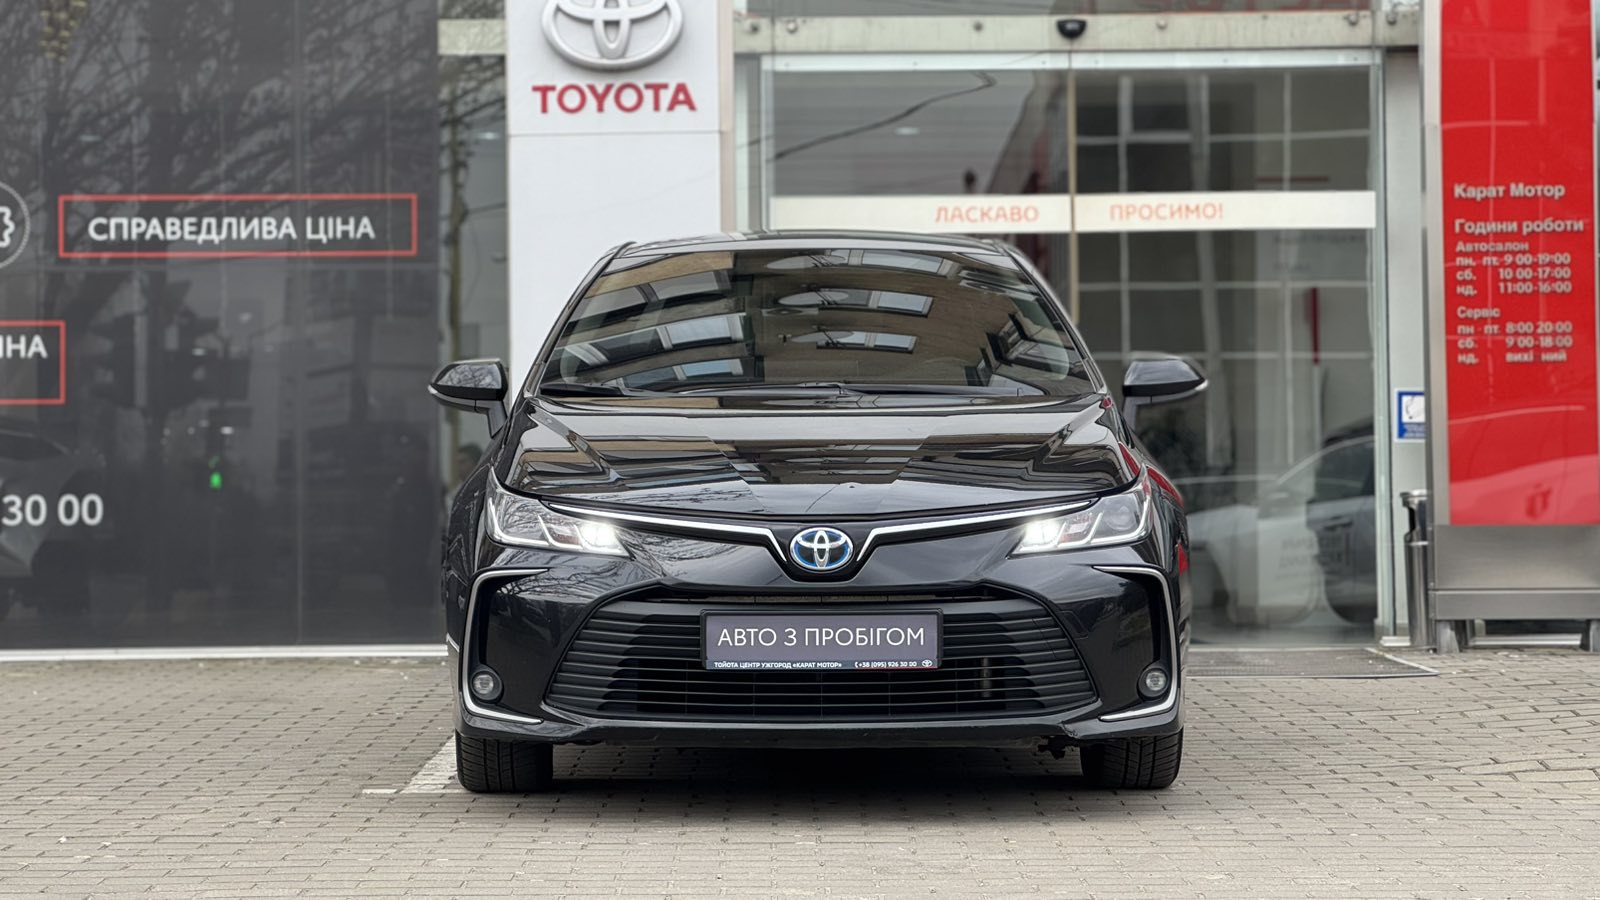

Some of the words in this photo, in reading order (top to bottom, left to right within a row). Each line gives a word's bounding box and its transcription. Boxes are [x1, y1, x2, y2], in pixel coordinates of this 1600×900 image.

[531, 82, 697, 114] TOYOTA
[1454, 182, 1506, 201] Карат
[1509, 182, 1566, 200] Мотор
[934, 206, 1040, 224] ЛАСКАВО
[1109, 203, 1224, 222] ПРОСИМО!
[88, 216, 298, 245] СПРАВЕДЛИВА
[305, 216, 376, 244] ЦІНА
[1454, 218, 1518, 236] Години
[1522, 216, 1584, 236] роботи
[1456, 240, 1530, 253] Автосалон
[1456, 268, 1477, 281] сб.
[1456, 305, 1501, 320] Сервіс
[1, 494, 47, 526] 30
[57, 493, 104, 526] 00
[717, 627, 777, 647] АВТО
[805, 627, 924, 646] ПРОБІГОМ
[714, 660, 739, 668] ТОЙОТА
[739, 661, 760, 669] ЦЕНТР
[761, 661, 792, 669] УЖГОРОД
